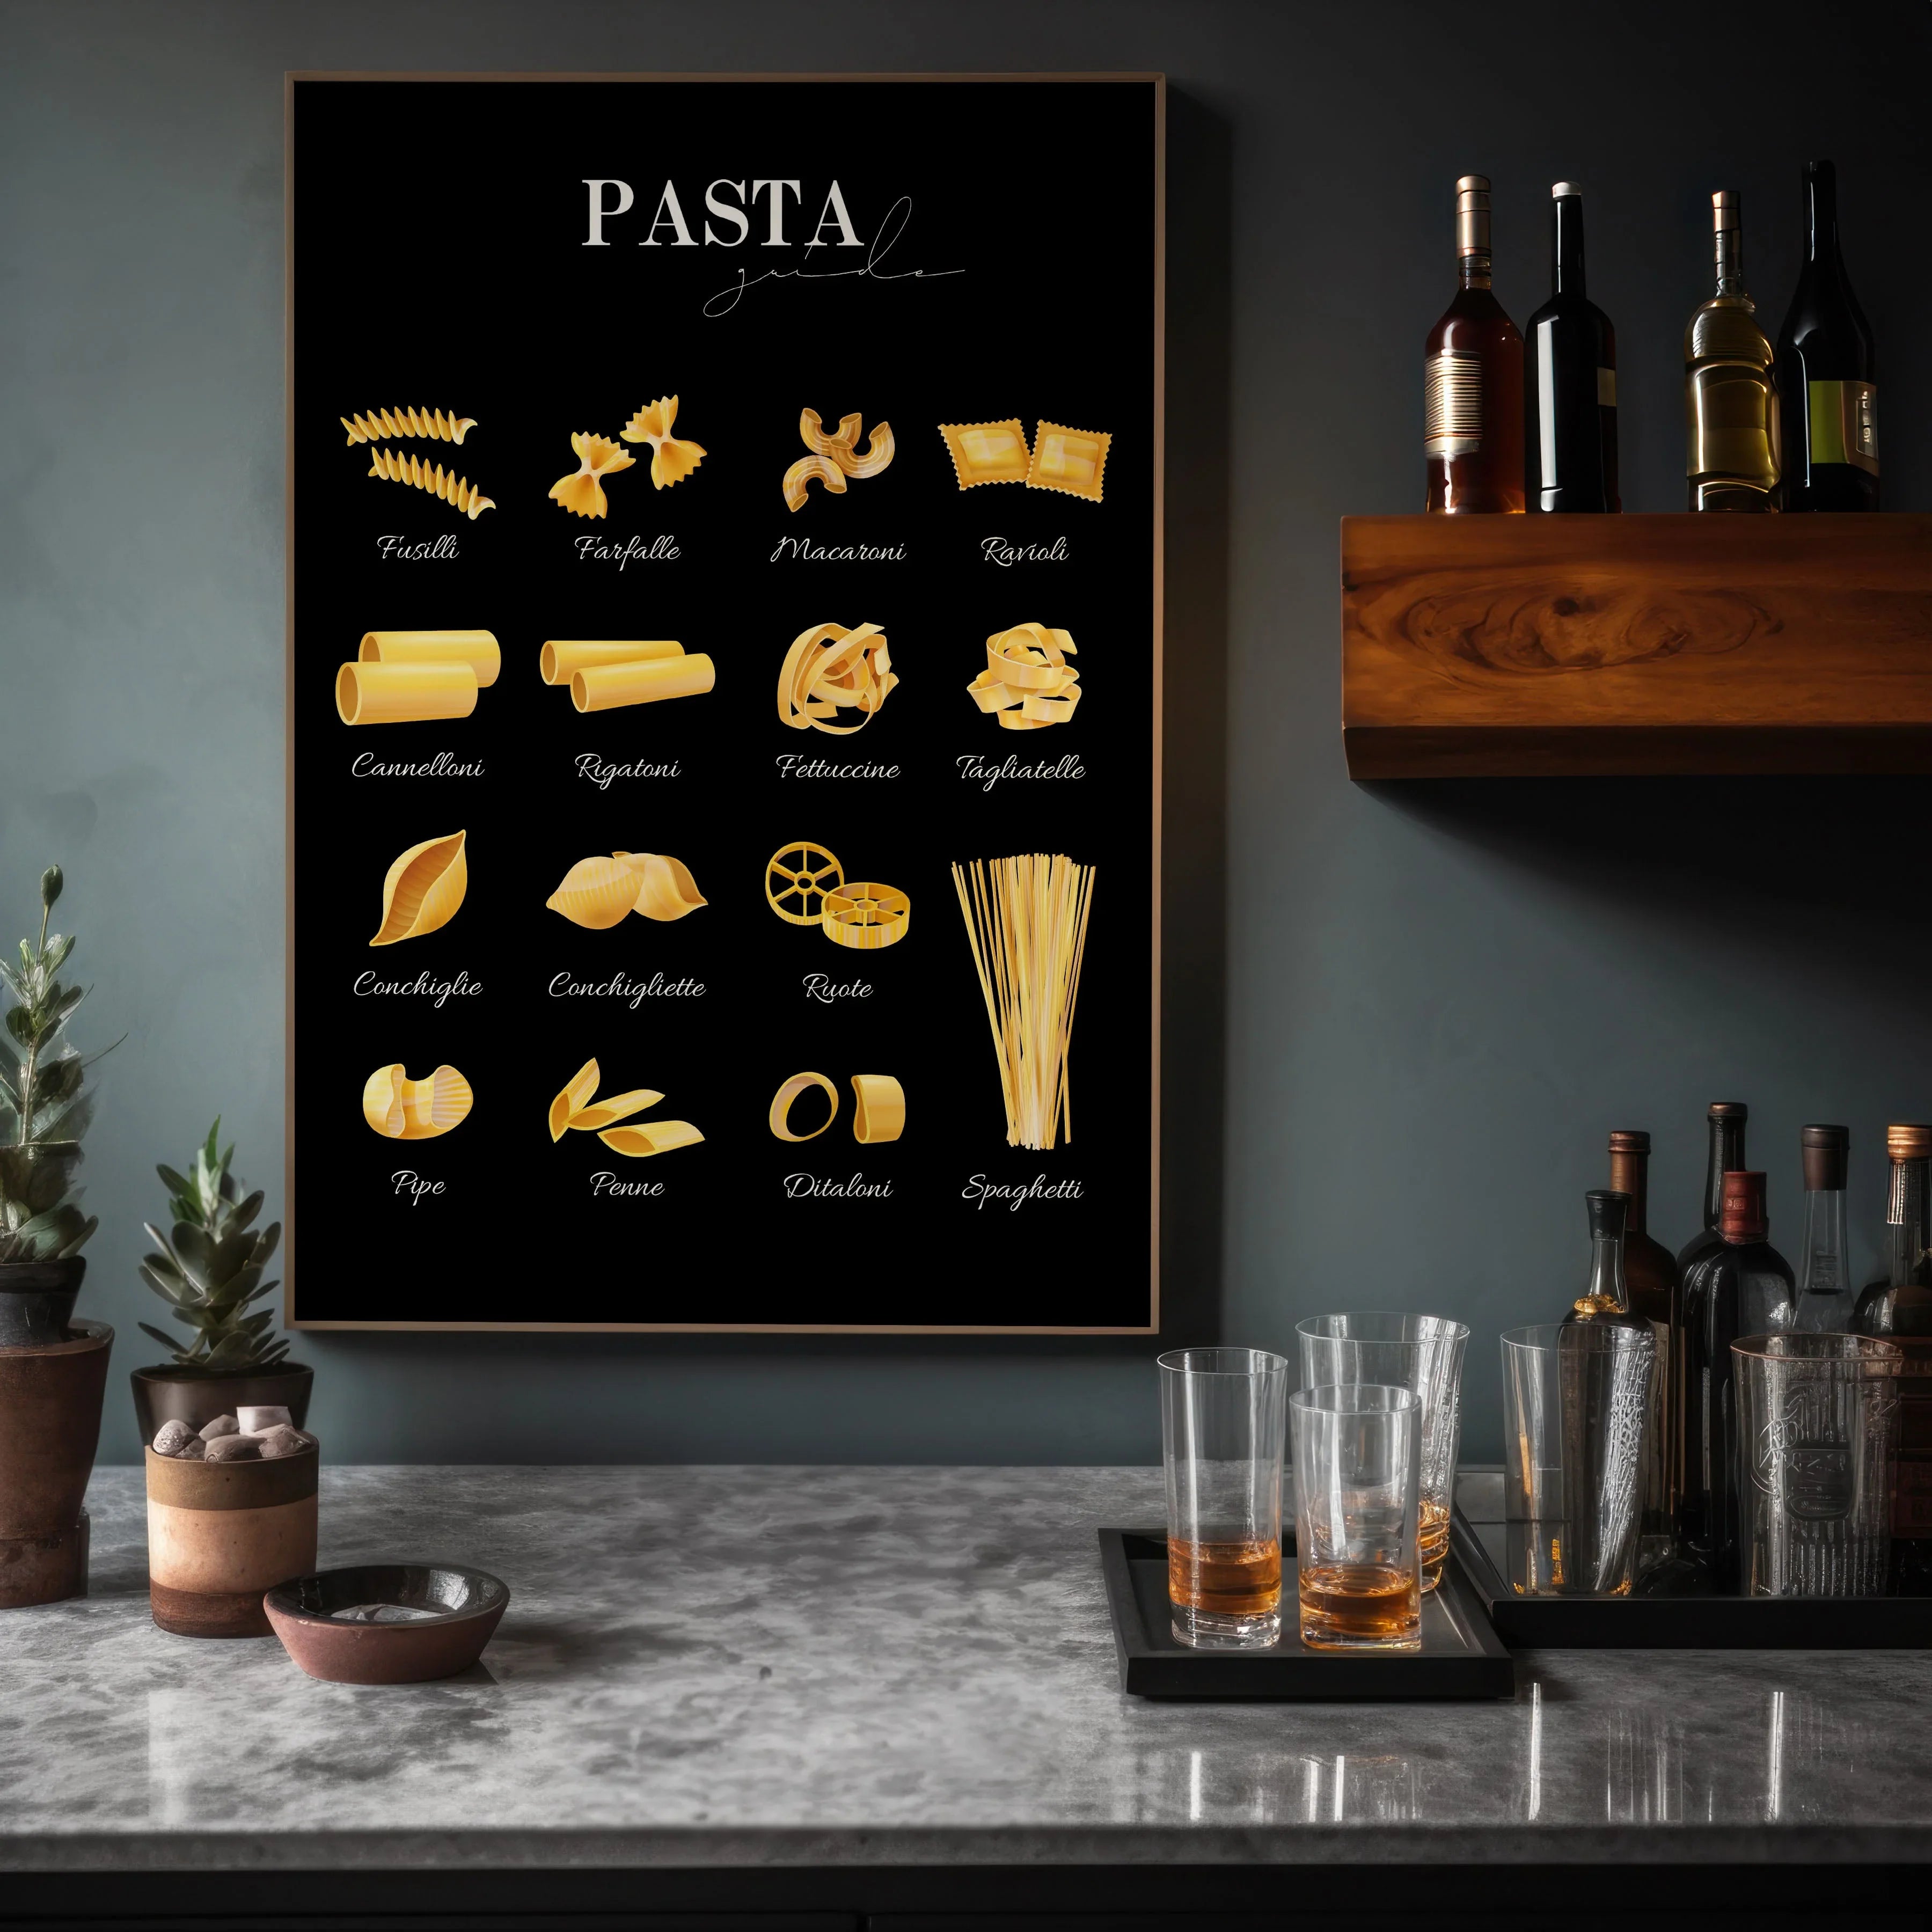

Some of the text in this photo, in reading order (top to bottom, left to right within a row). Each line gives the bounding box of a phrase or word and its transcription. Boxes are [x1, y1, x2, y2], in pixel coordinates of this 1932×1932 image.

[582, 179, 865, 246] PASTA
[704, 196, 965, 317] guide
[377, 535, 459, 560] Fusilli
[575, 536, 681, 571] Farfalle
[771, 537, 906, 562] Macaroni
[981, 537, 1069, 566] Ravioli
[352, 752, 485, 777] Cannelloni
[575, 753, 681, 790] Rigatoni
[776, 755, 901, 779] Fettuccine
[956, 755, 1086, 792] Tagliatelle
[354, 971, 483, 1008] Conchiglie
[549, 972, 706, 1009] Conchigliette
[803, 974, 873, 1003] Ruote
[392, 1170, 446, 1206] Pipe
[590, 1172, 665, 1197] Penne
[784, 1173, 893, 1199] Ditaloni
[962, 1174, 1084, 1212] Spaghetti
